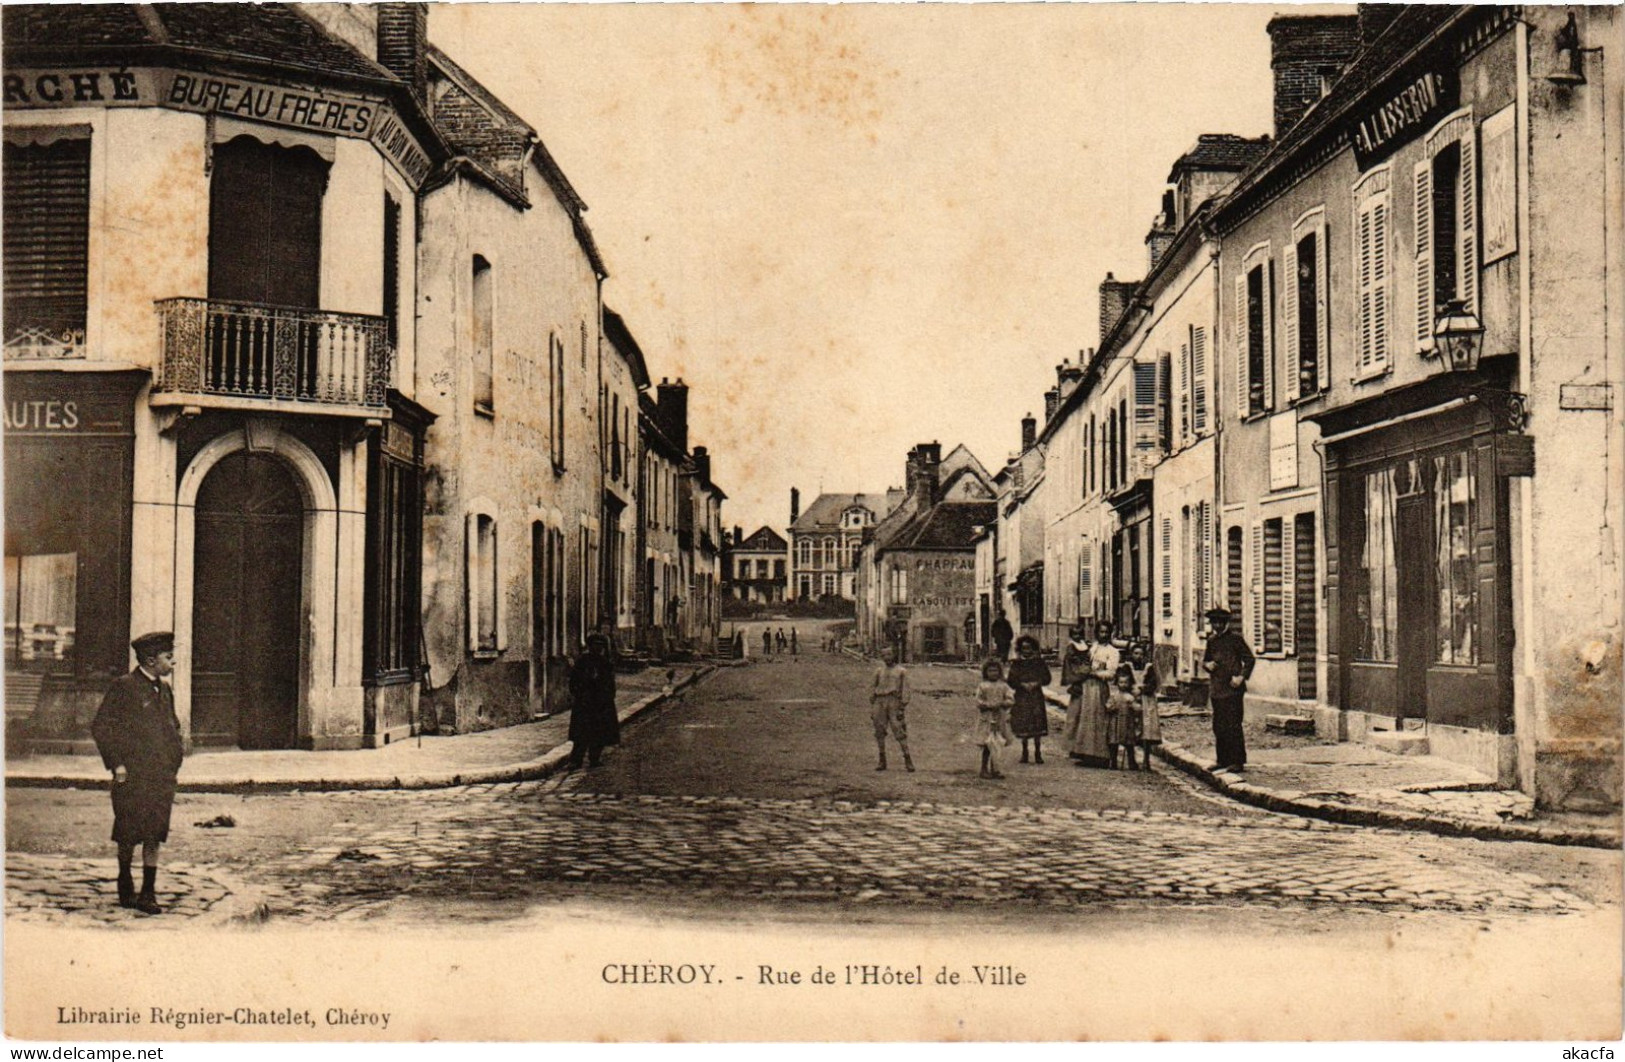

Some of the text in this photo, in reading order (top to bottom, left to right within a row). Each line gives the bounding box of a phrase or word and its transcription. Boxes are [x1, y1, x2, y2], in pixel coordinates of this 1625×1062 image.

[170, 74, 275, 118] BUREAU
[376, 117, 397, 144] AU
[386, 128, 411, 159] BON
